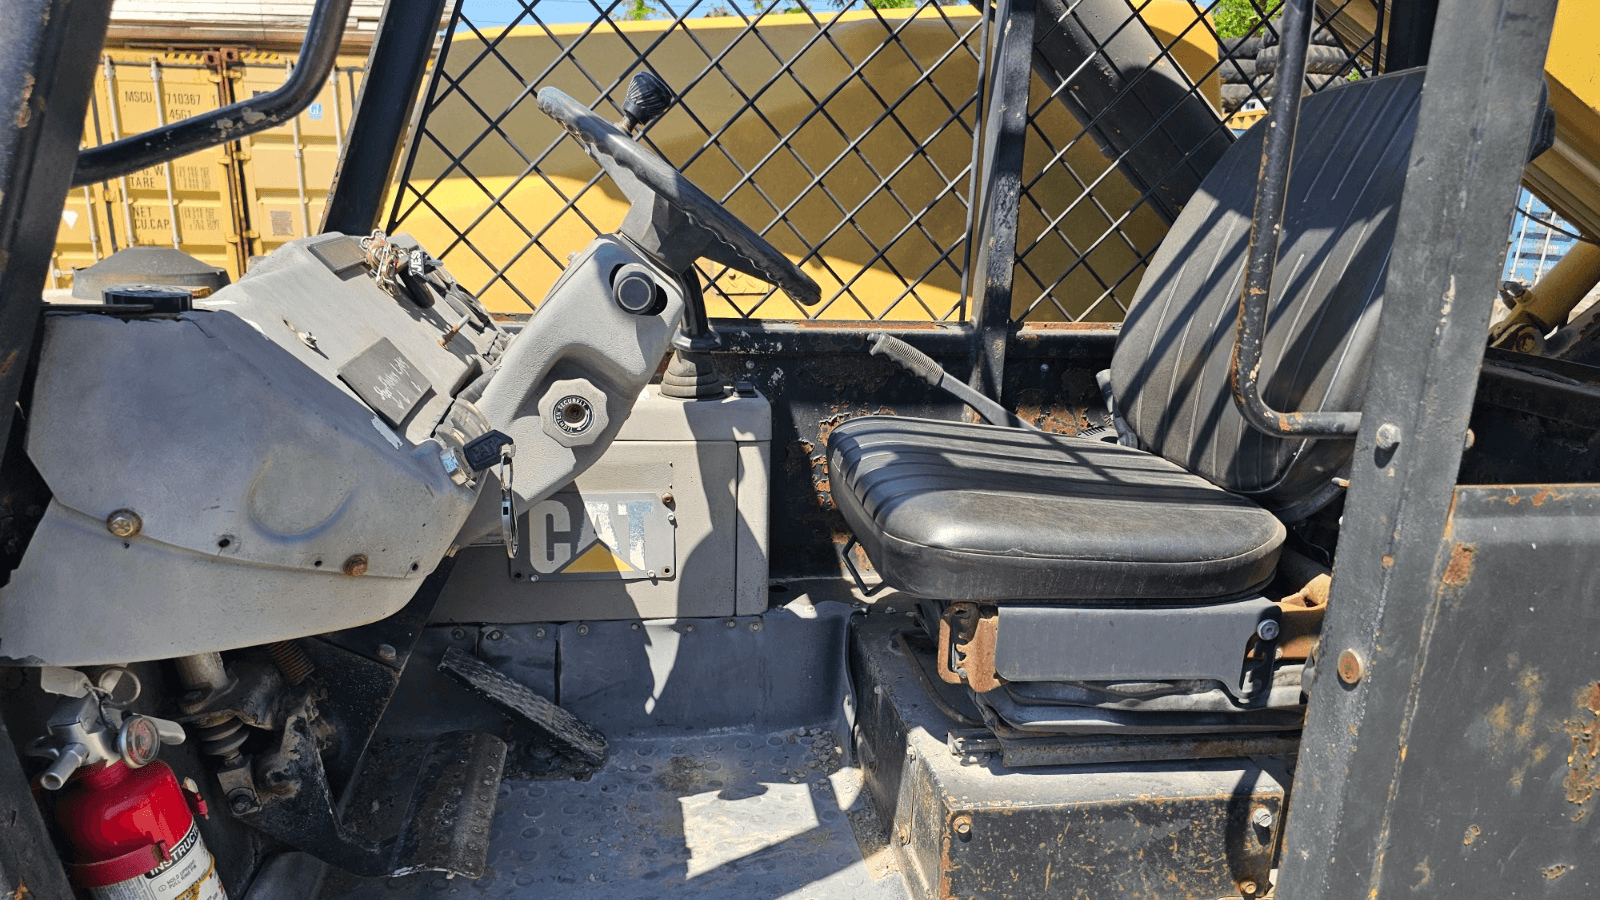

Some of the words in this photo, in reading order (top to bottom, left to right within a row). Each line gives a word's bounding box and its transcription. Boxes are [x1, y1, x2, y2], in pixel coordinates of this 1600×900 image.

[125, 91, 153, 103] MSCU
[165, 93, 201, 105] 710367
[130, 177, 155, 188] TARE
[133, 207, 152, 218] NET
[555, 411, 573, 433] TIGHTEN
[529, 500, 653, 573] CAT
